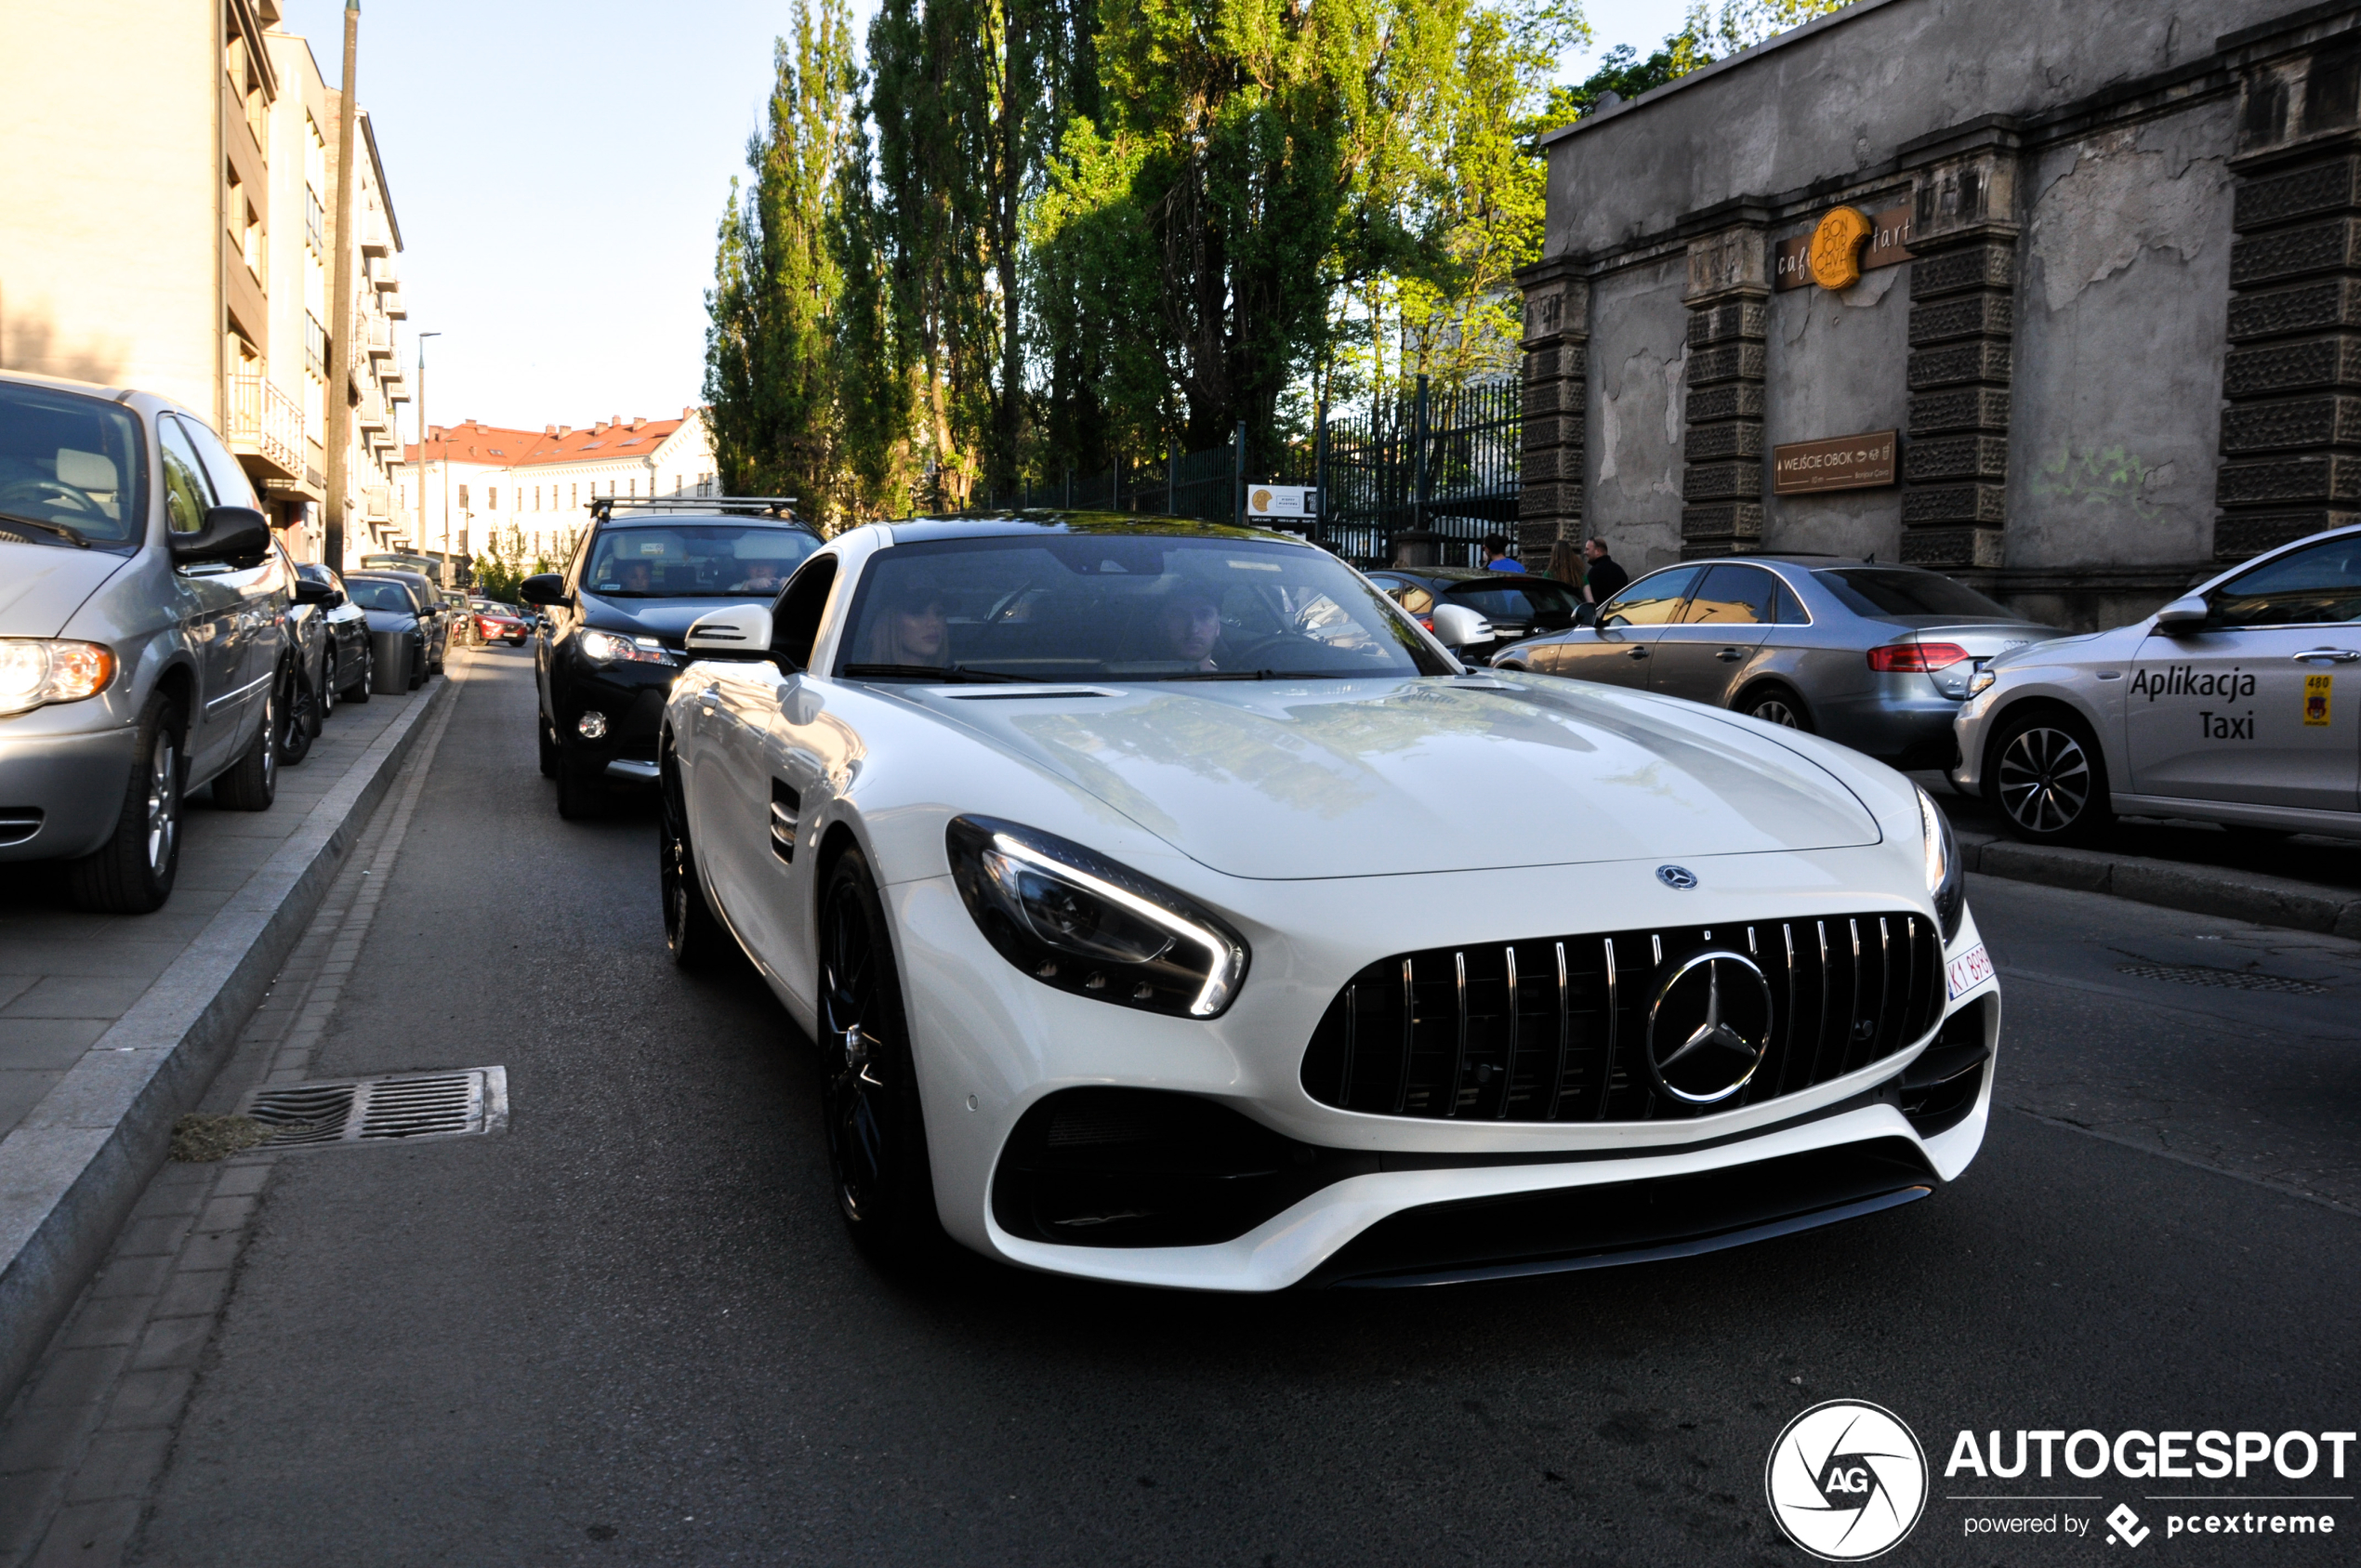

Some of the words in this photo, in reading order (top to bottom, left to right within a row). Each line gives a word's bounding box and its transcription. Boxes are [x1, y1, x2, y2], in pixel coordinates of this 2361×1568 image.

[1822, 217, 1849, 240] BON
[1778, 246, 1811, 281] caf
[1784, 454, 1823, 471] WEJŚCIE
[1824, 451, 1853, 468] OBOK
[1854, 470, 1874, 480] Bonjour
[2130, 665, 2256, 704] Aplikacja
[2307, 677, 2329, 689] 480
[2199, 710, 2255, 740] Taxi
[1948, 960, 1969, 994] K1
